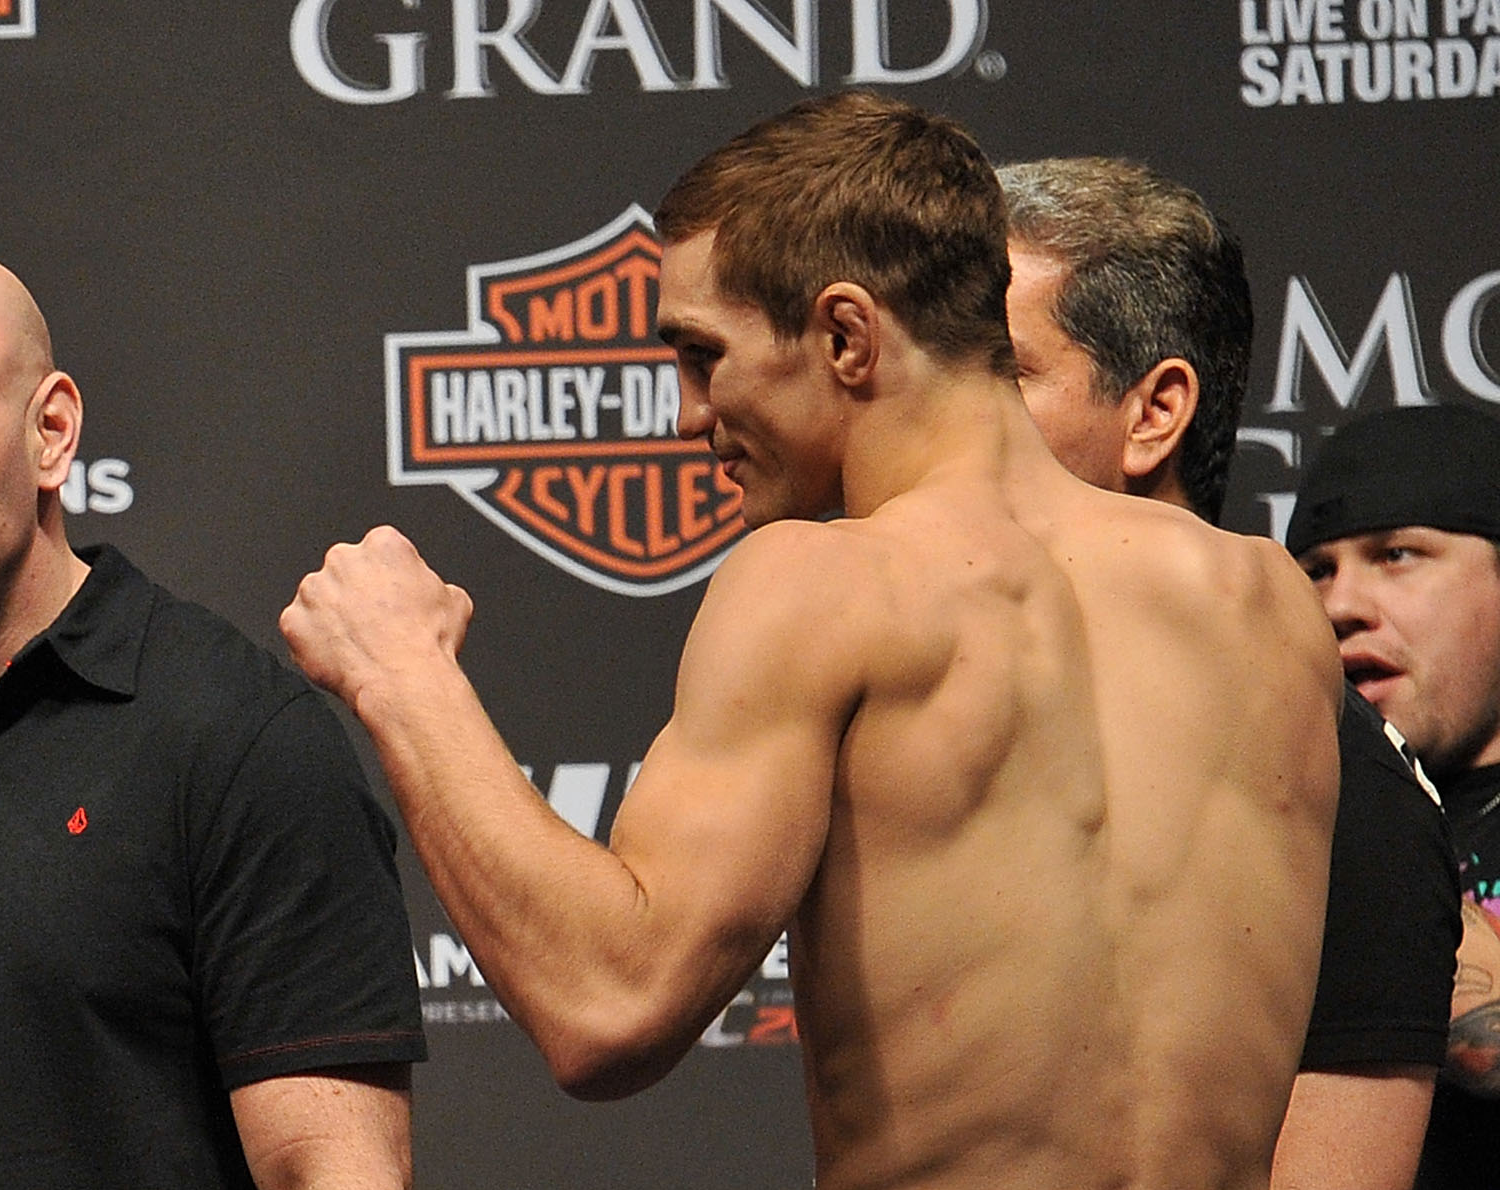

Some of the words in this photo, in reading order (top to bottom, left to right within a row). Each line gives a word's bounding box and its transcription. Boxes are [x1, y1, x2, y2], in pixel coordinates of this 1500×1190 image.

[289, 0, 988, 104] GRAND
[1240, 0, 1346, 44] LIVE
[1359, 0, 1429, 40] ON
[1239, 36, 1500, 107] SATURDA
[528, 254, 660, 343] MOT
[431, 364, 680, 443] HARLEY-DA
